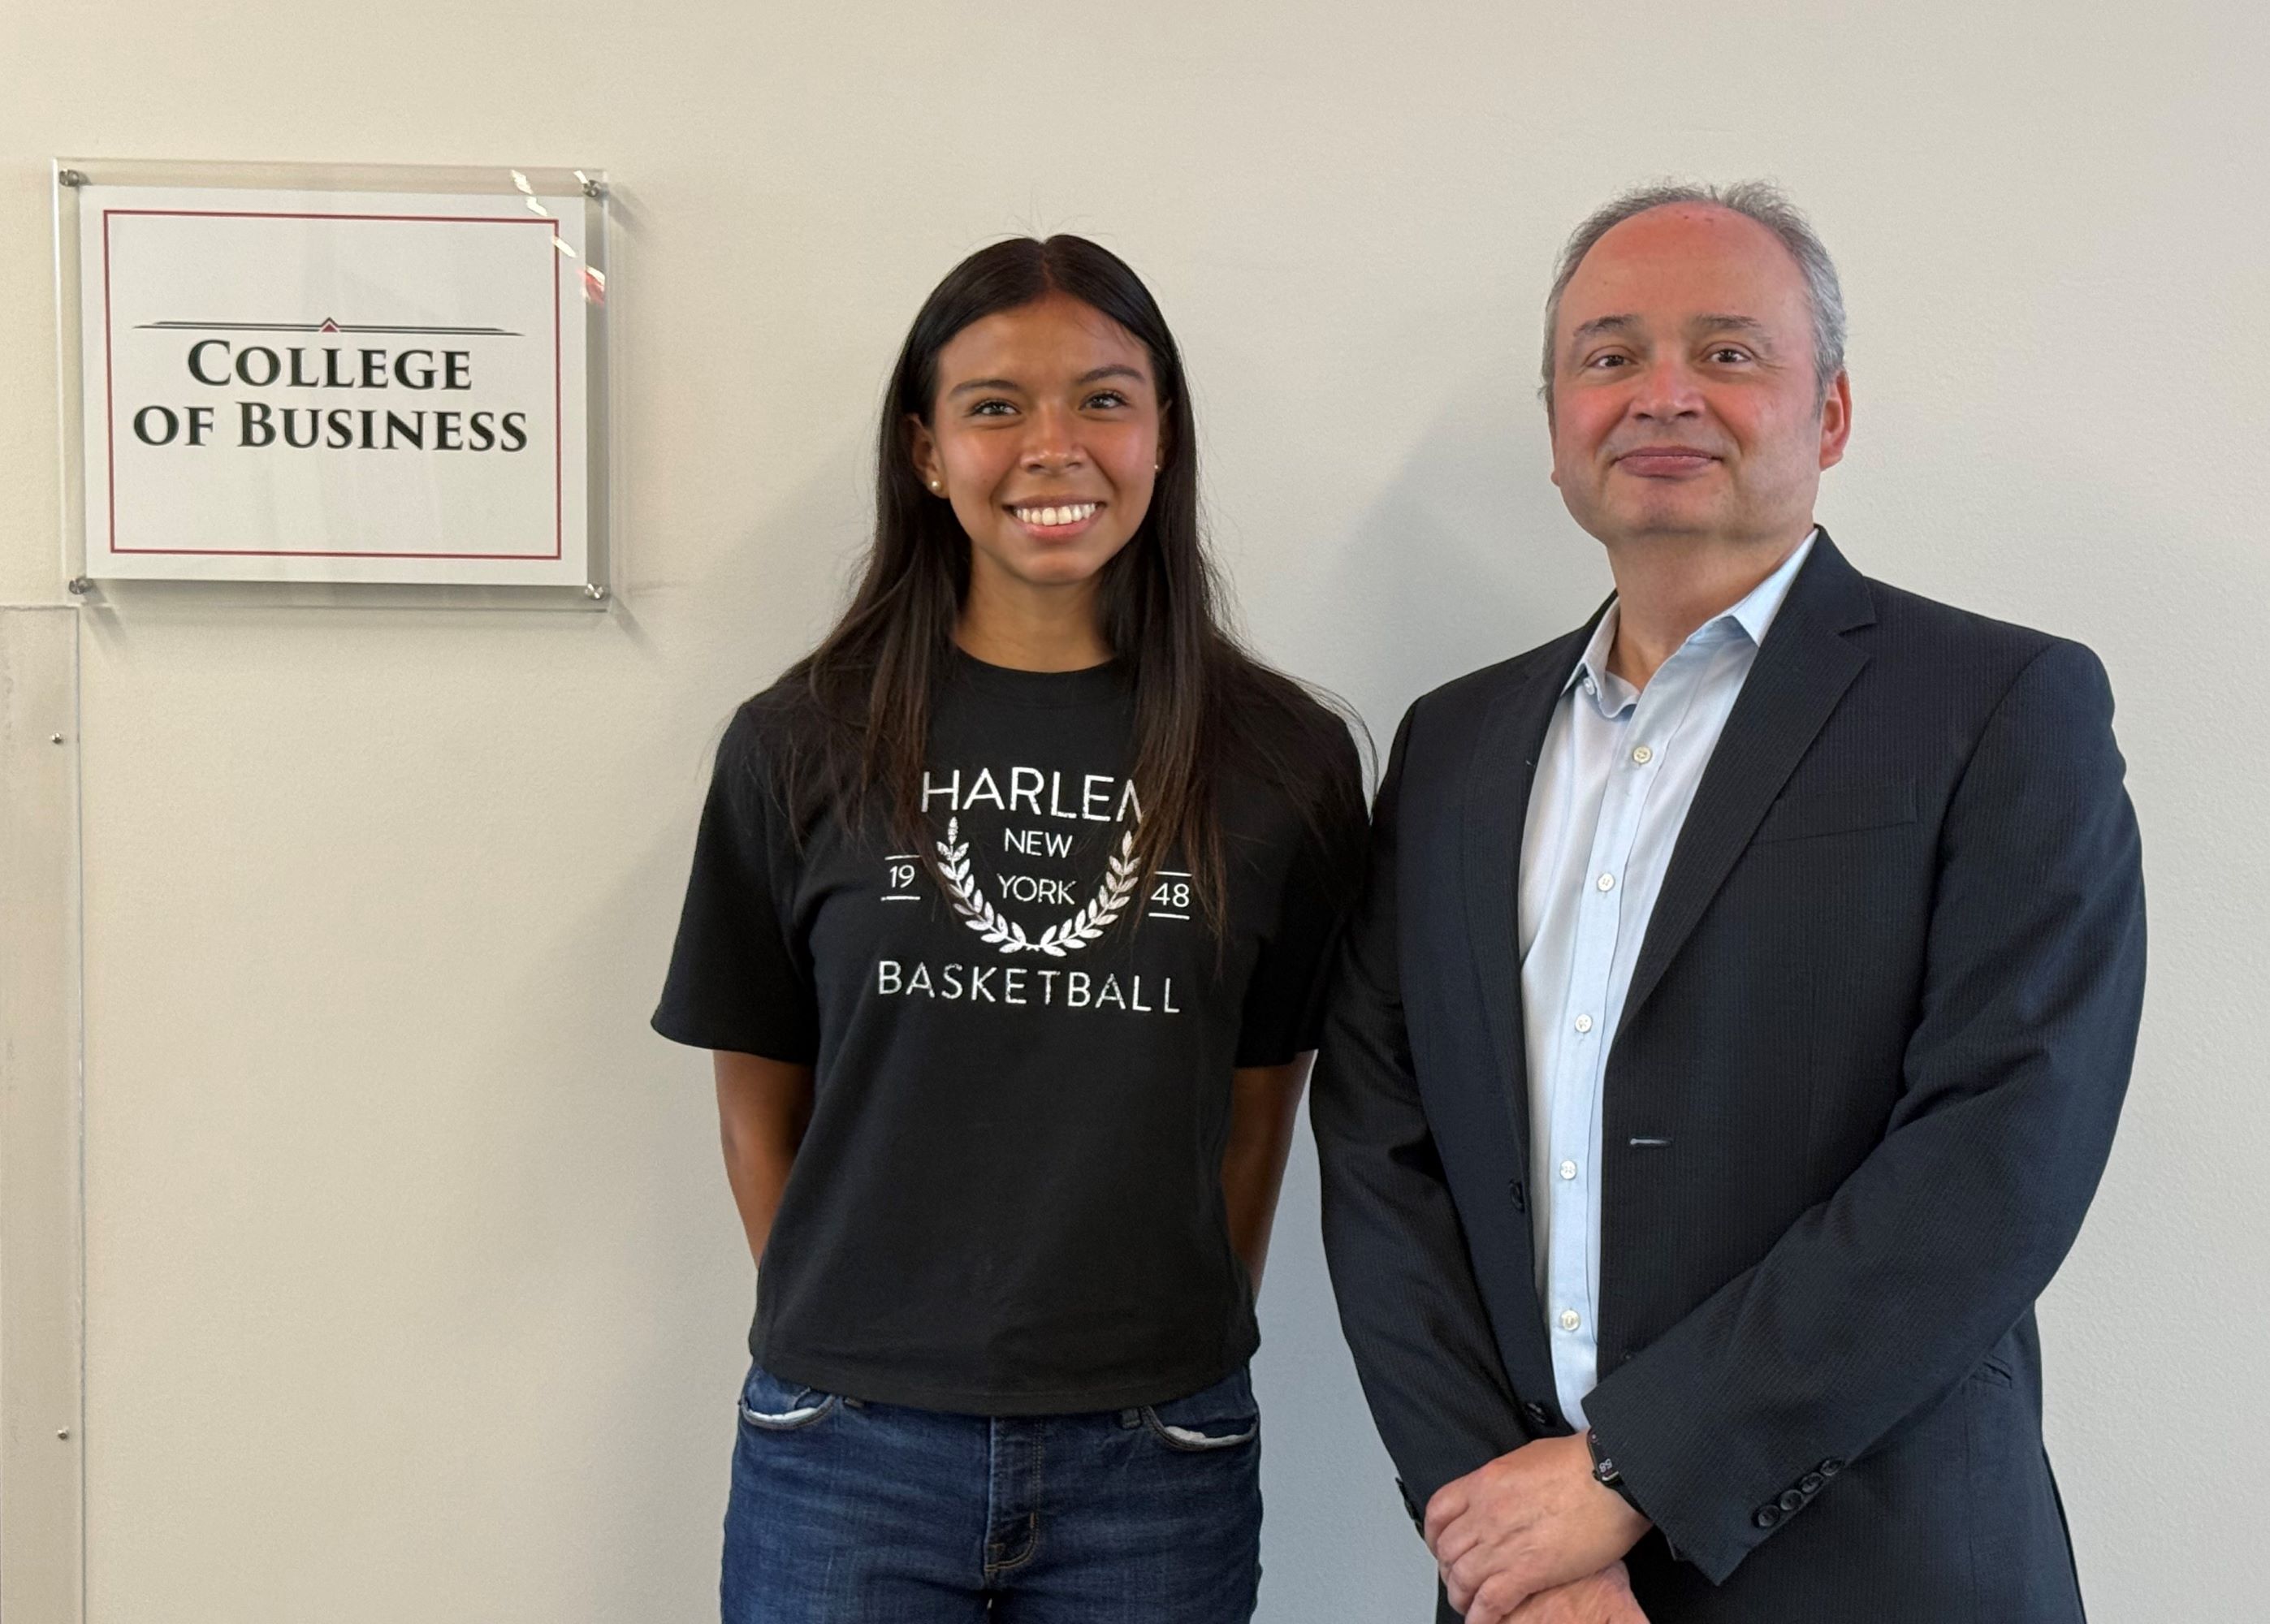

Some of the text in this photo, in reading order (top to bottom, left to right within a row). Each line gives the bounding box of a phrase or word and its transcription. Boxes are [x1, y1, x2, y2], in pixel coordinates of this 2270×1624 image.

[188, 339, 473, 391] COLLEGE
[133, 401, 528, 453] OF BUSINESS
[1004, 827, 1074, 859] NEW
[889, 864, 917, 889] 19
[997, 873, 1078, 905] YORK
[1149, 883, 1191, 909] 48
[878, 960, 1181, 1014] BASKETBALL
